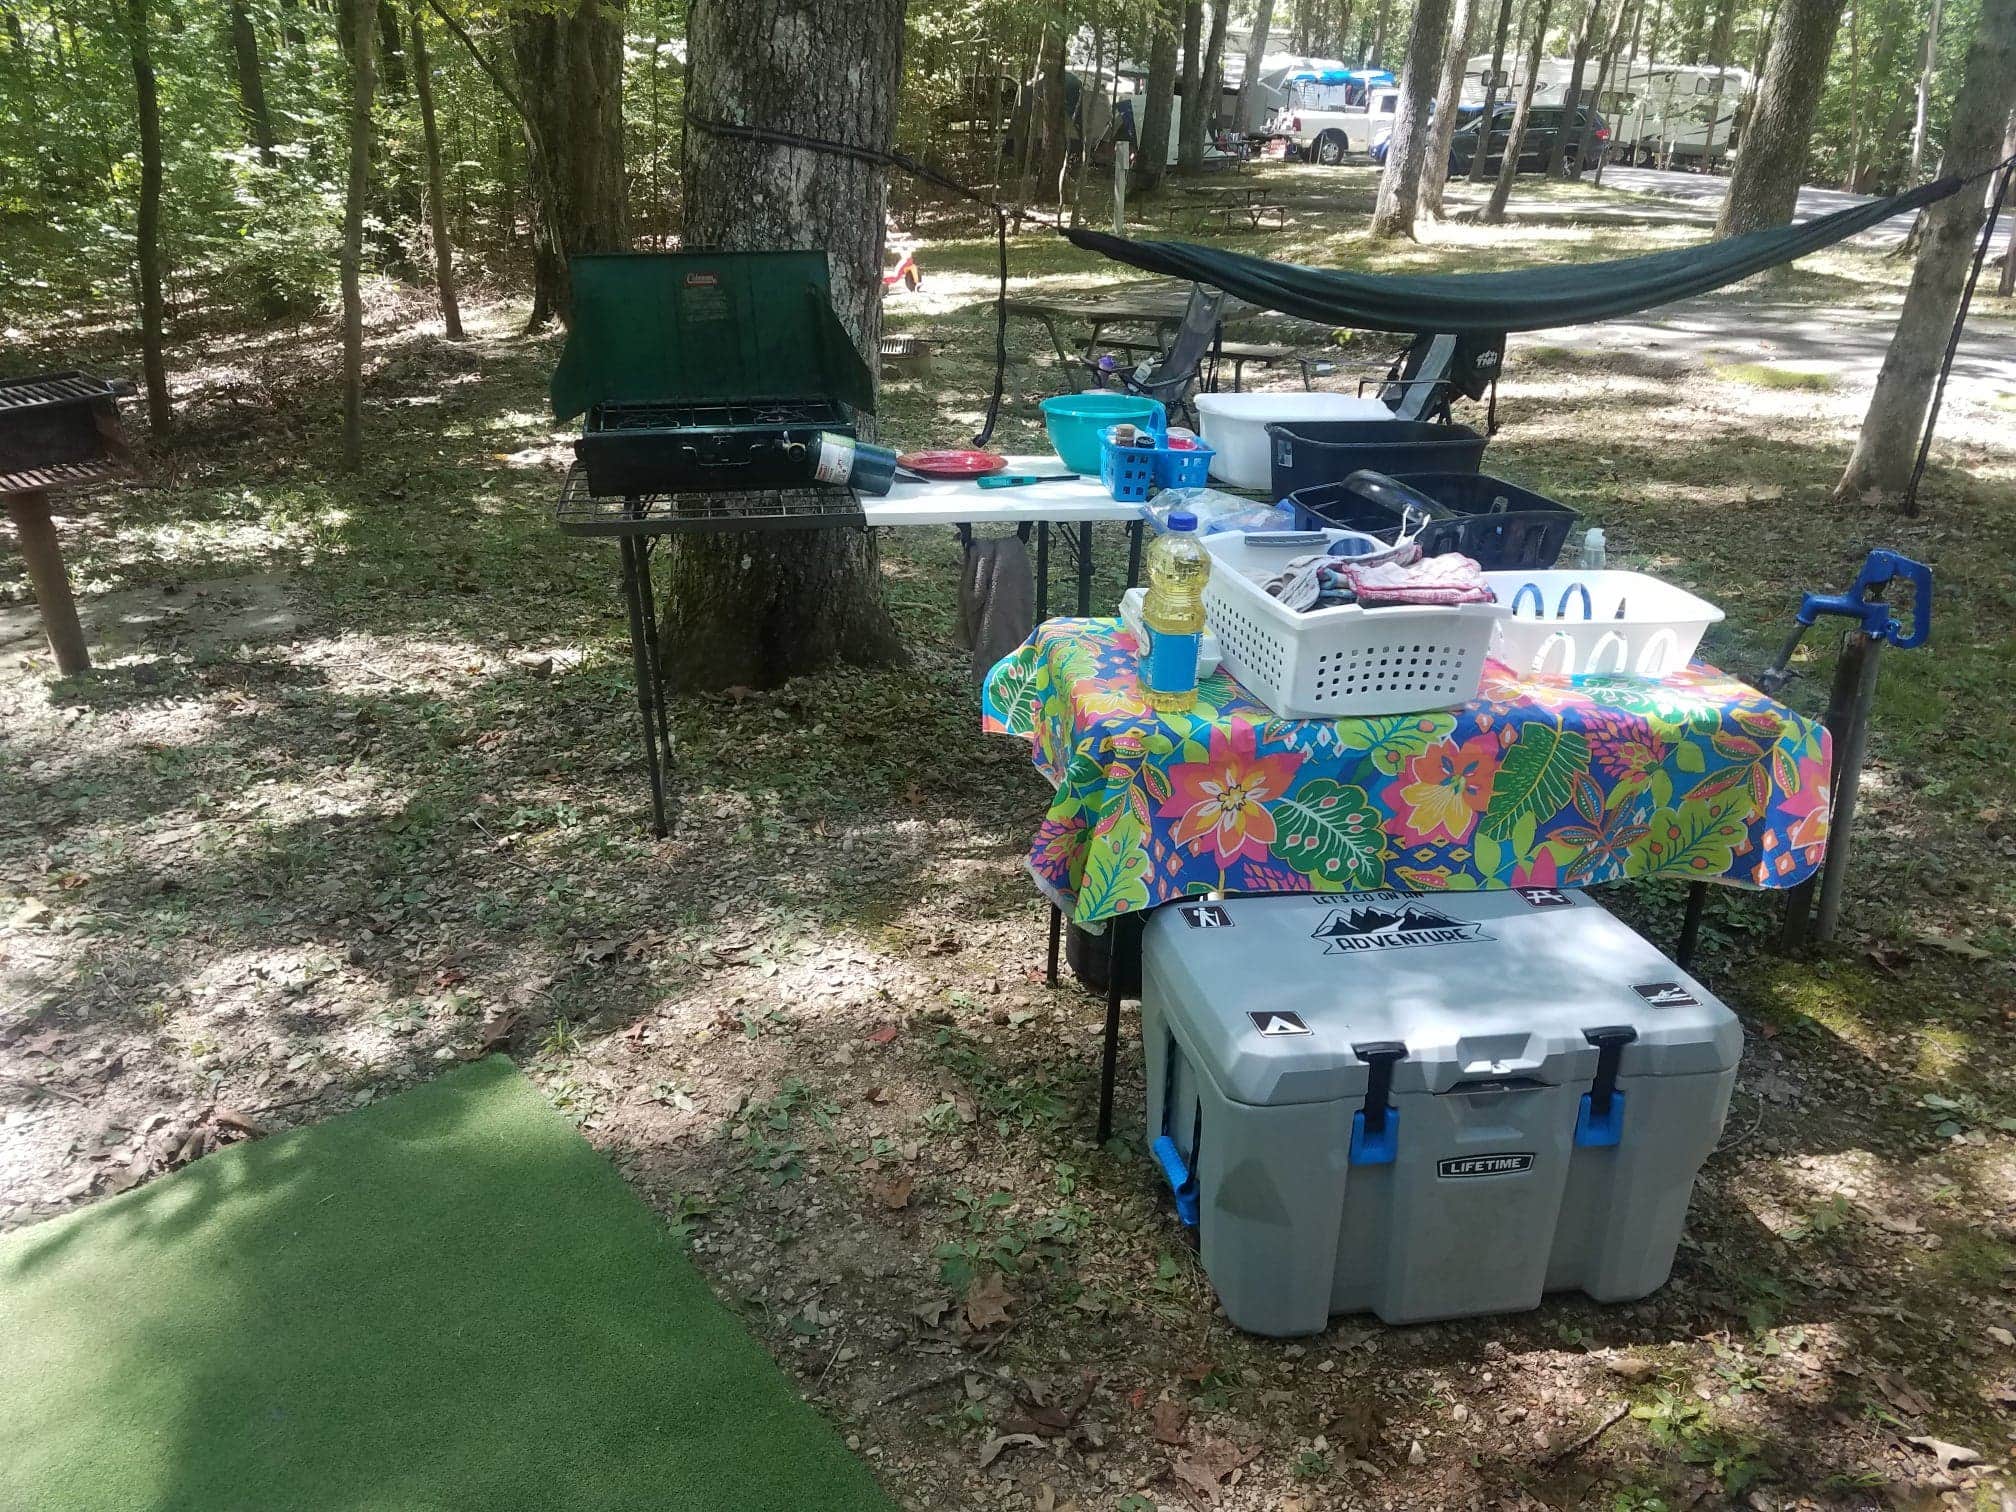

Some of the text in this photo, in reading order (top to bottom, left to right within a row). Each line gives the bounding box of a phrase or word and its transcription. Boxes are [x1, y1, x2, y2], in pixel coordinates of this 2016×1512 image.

[1312, 894, 1349, 905] LET'S
[1353, 893, 1375, 903] GO
[1378, 892, 1400, 901] ON
[1335, 928, 1473, 950] ADVENTURE
[1450, 1158, 1522, 1173] LIFETIME
